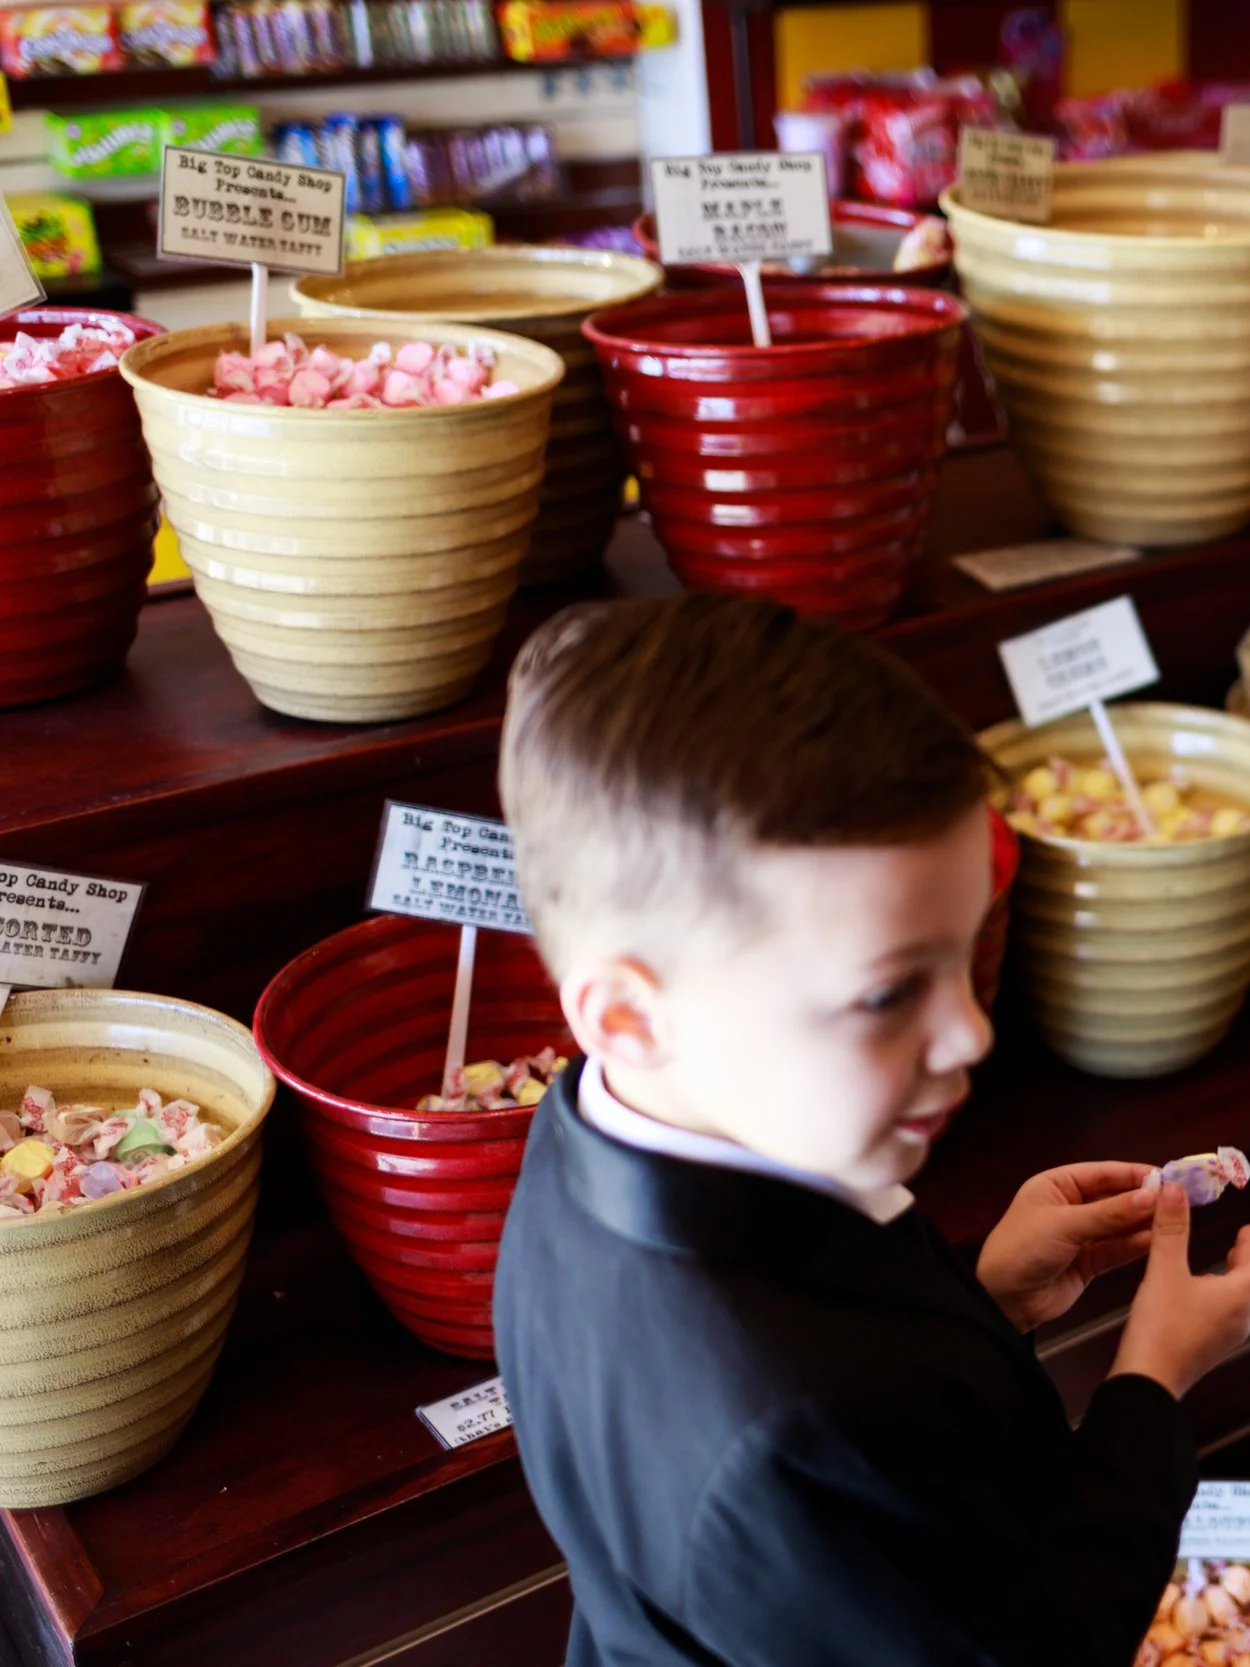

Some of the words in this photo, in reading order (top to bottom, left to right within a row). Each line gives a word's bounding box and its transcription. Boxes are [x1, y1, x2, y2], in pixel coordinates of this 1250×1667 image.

[178, 154, 207, 174] Big
[215, 161, 241, 179] Top
[247, 166, 292, 187] Candy
[298, 174, 333, 194] Shop
[173, 195, 273, 228] BUBBLE
[281, 210, 332, 236] GUM
[181, 227, 218, 242] SALT
[223, 232, 275, 250] WATER
[279, 241, 322, 256] TAFFY
[402, 812, 433, 832] Big
[442, 820, 472, 839] Top
[478, 826, 512, 843] Can
[0, 872, 18, 888] op
[26, 873, 80, 896] Candy
[85, 882, 129, 904] Shop
[0, 890, 80, 913] resents...
[409, 876, 519, 911] LEMONA
[439, 902, 498, 920] WATER
[0, 916, 92, 947] ORTED
[0, 940, 44, 958] ATER
[50, 947, 103, 965] TAFFY
